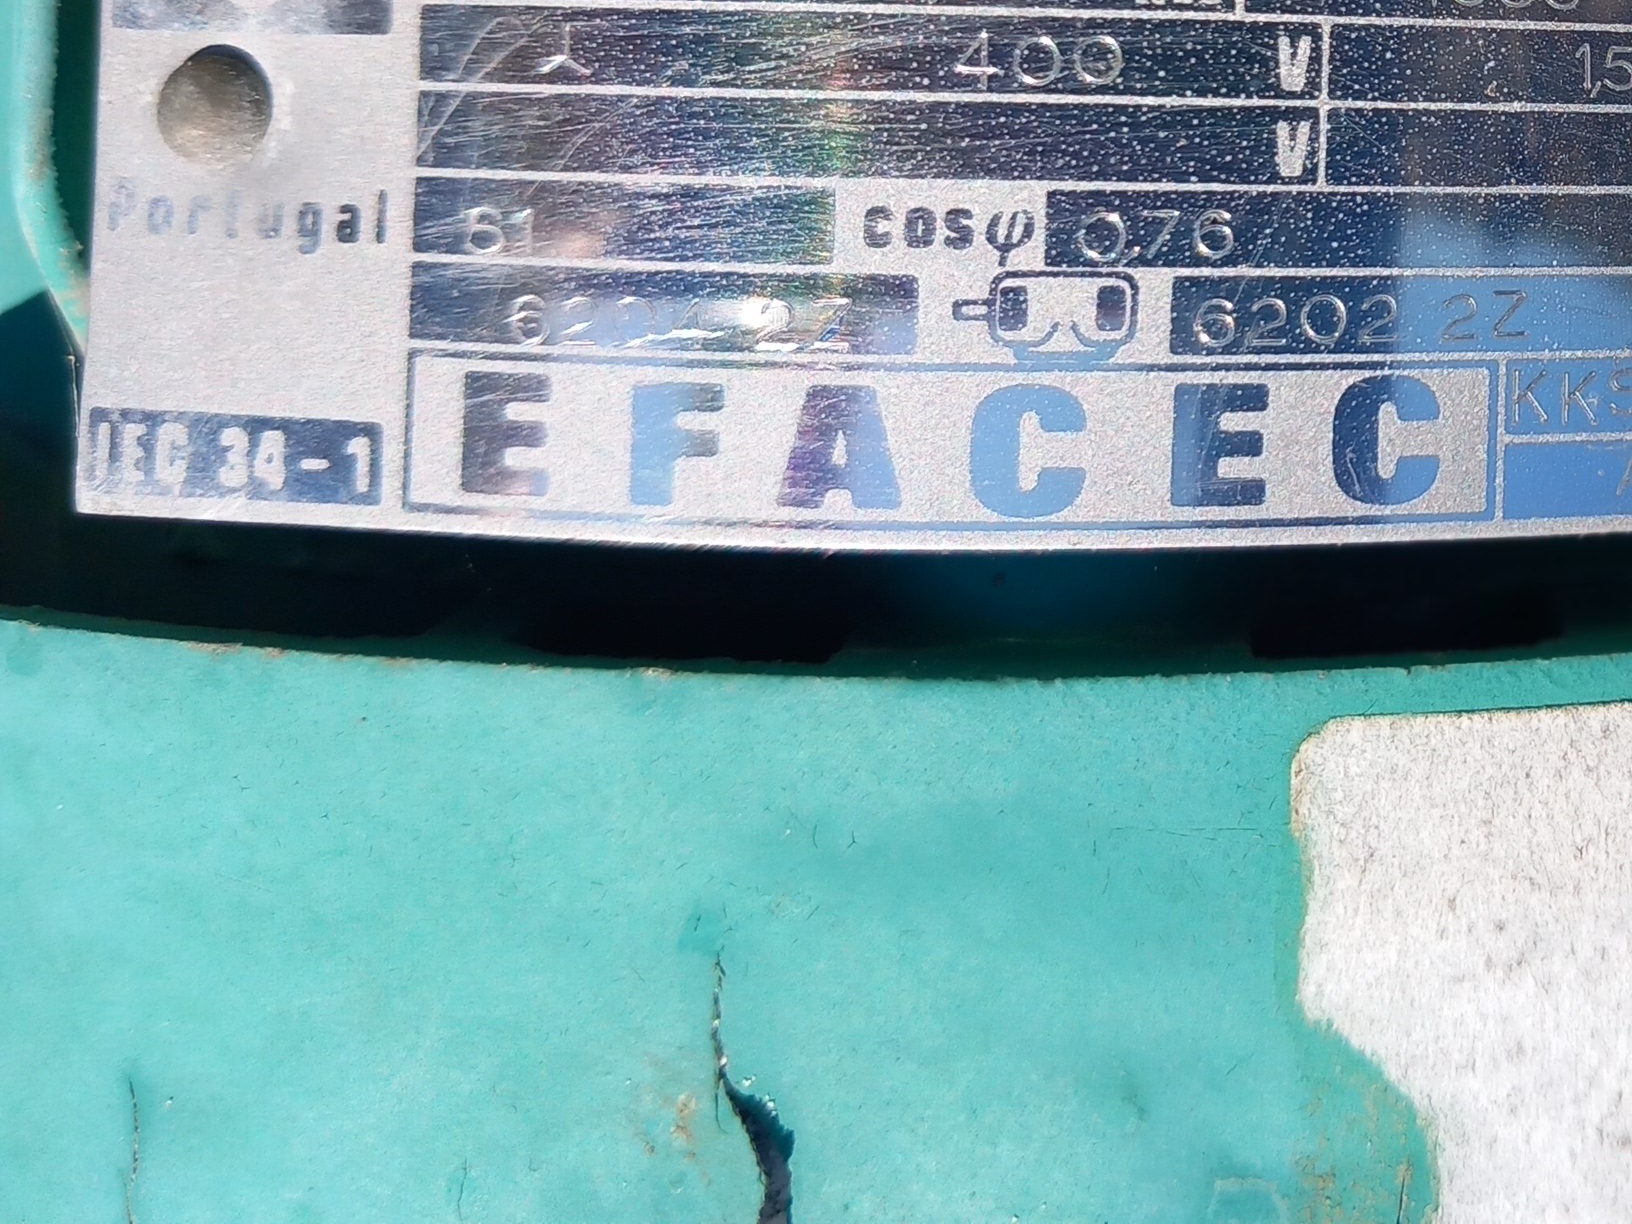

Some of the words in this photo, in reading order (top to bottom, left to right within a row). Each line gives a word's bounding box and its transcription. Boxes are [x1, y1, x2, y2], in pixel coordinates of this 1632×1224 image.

[954, 30, 1125, 91] 400
[1276, 35, 1312, 92] V
[1274, 120, 1311, 177] V
[107, 178, 388, 254] Portugal
[1193, 292, 1399, 348] 6202
[1441, 289, 1531, 343] 2Z
[96, 419, 190, 491] IEC
[460, 369, 1441, 518] EFACEC
